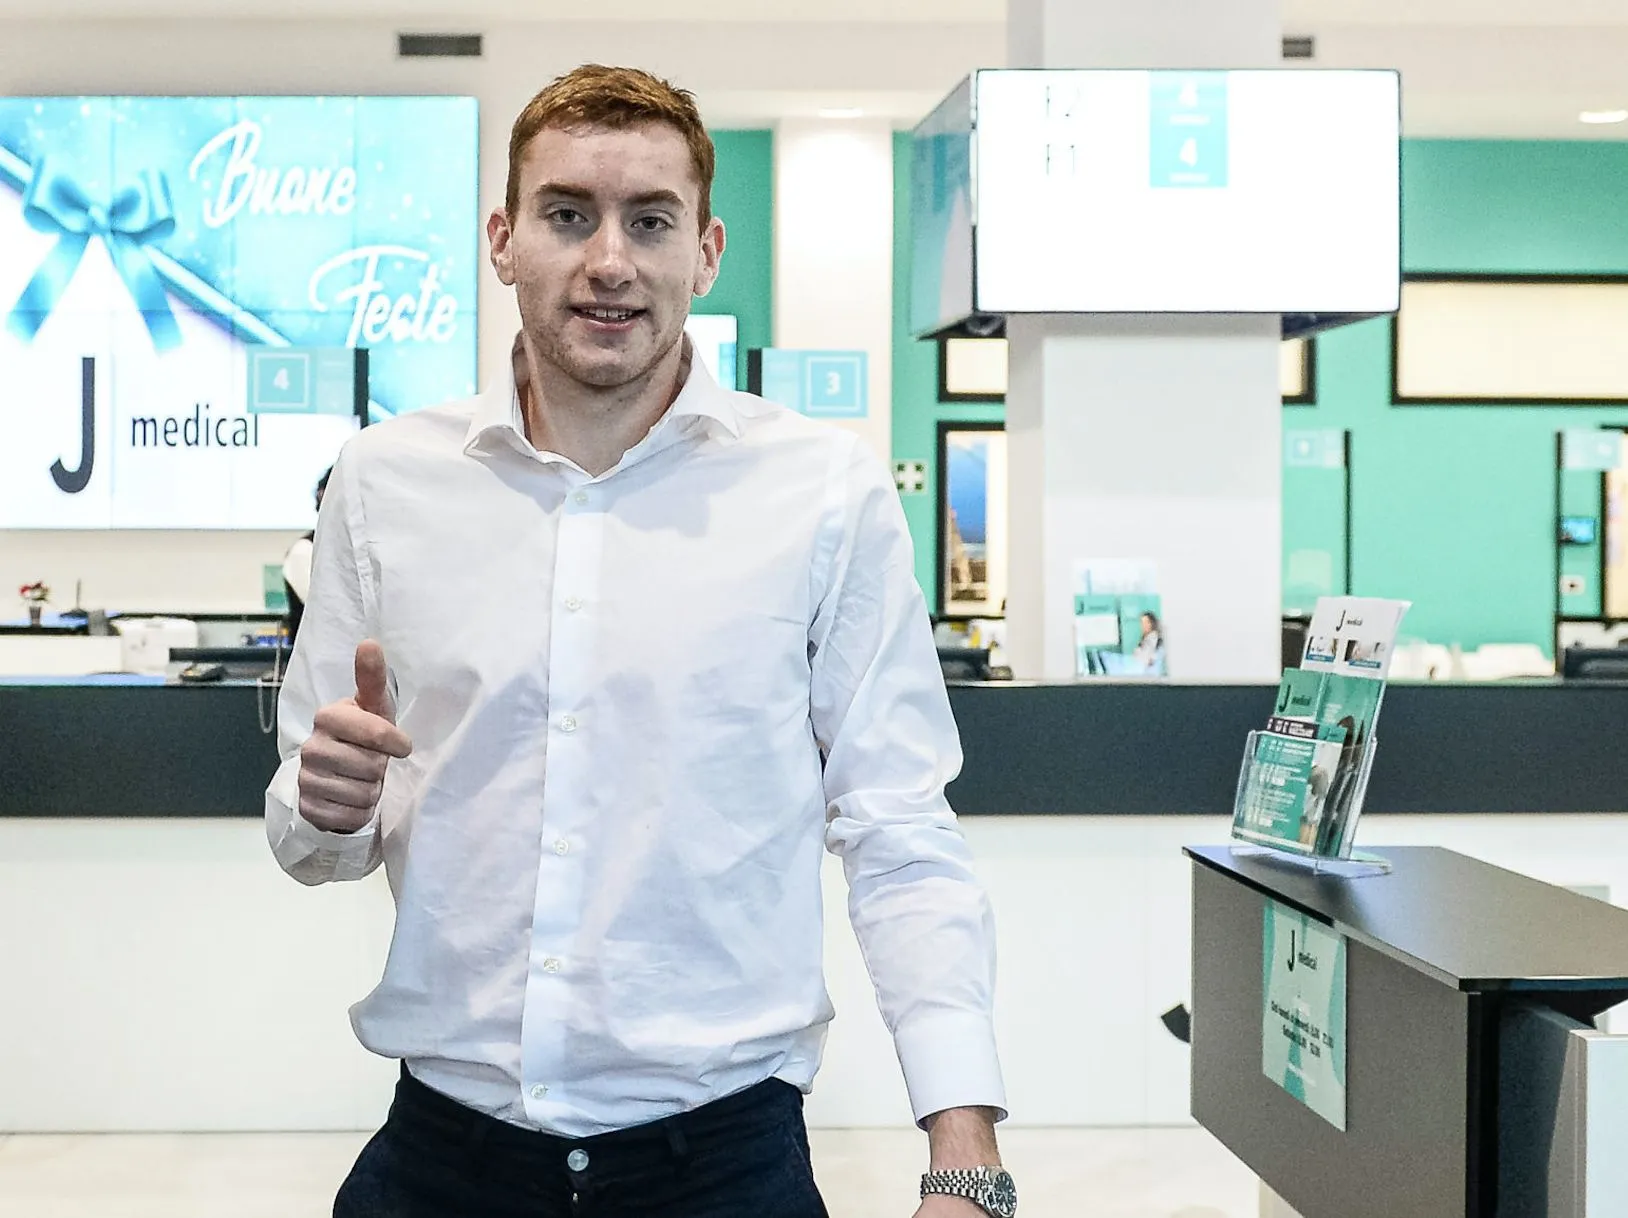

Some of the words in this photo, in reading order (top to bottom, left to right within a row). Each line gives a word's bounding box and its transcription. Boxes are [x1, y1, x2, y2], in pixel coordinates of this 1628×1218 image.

[273, 367, 290, 391] 4
[825, 370, 842, 397] 3
[50, 357, 95, 494] J
[131, 403, 259, 447] medical
